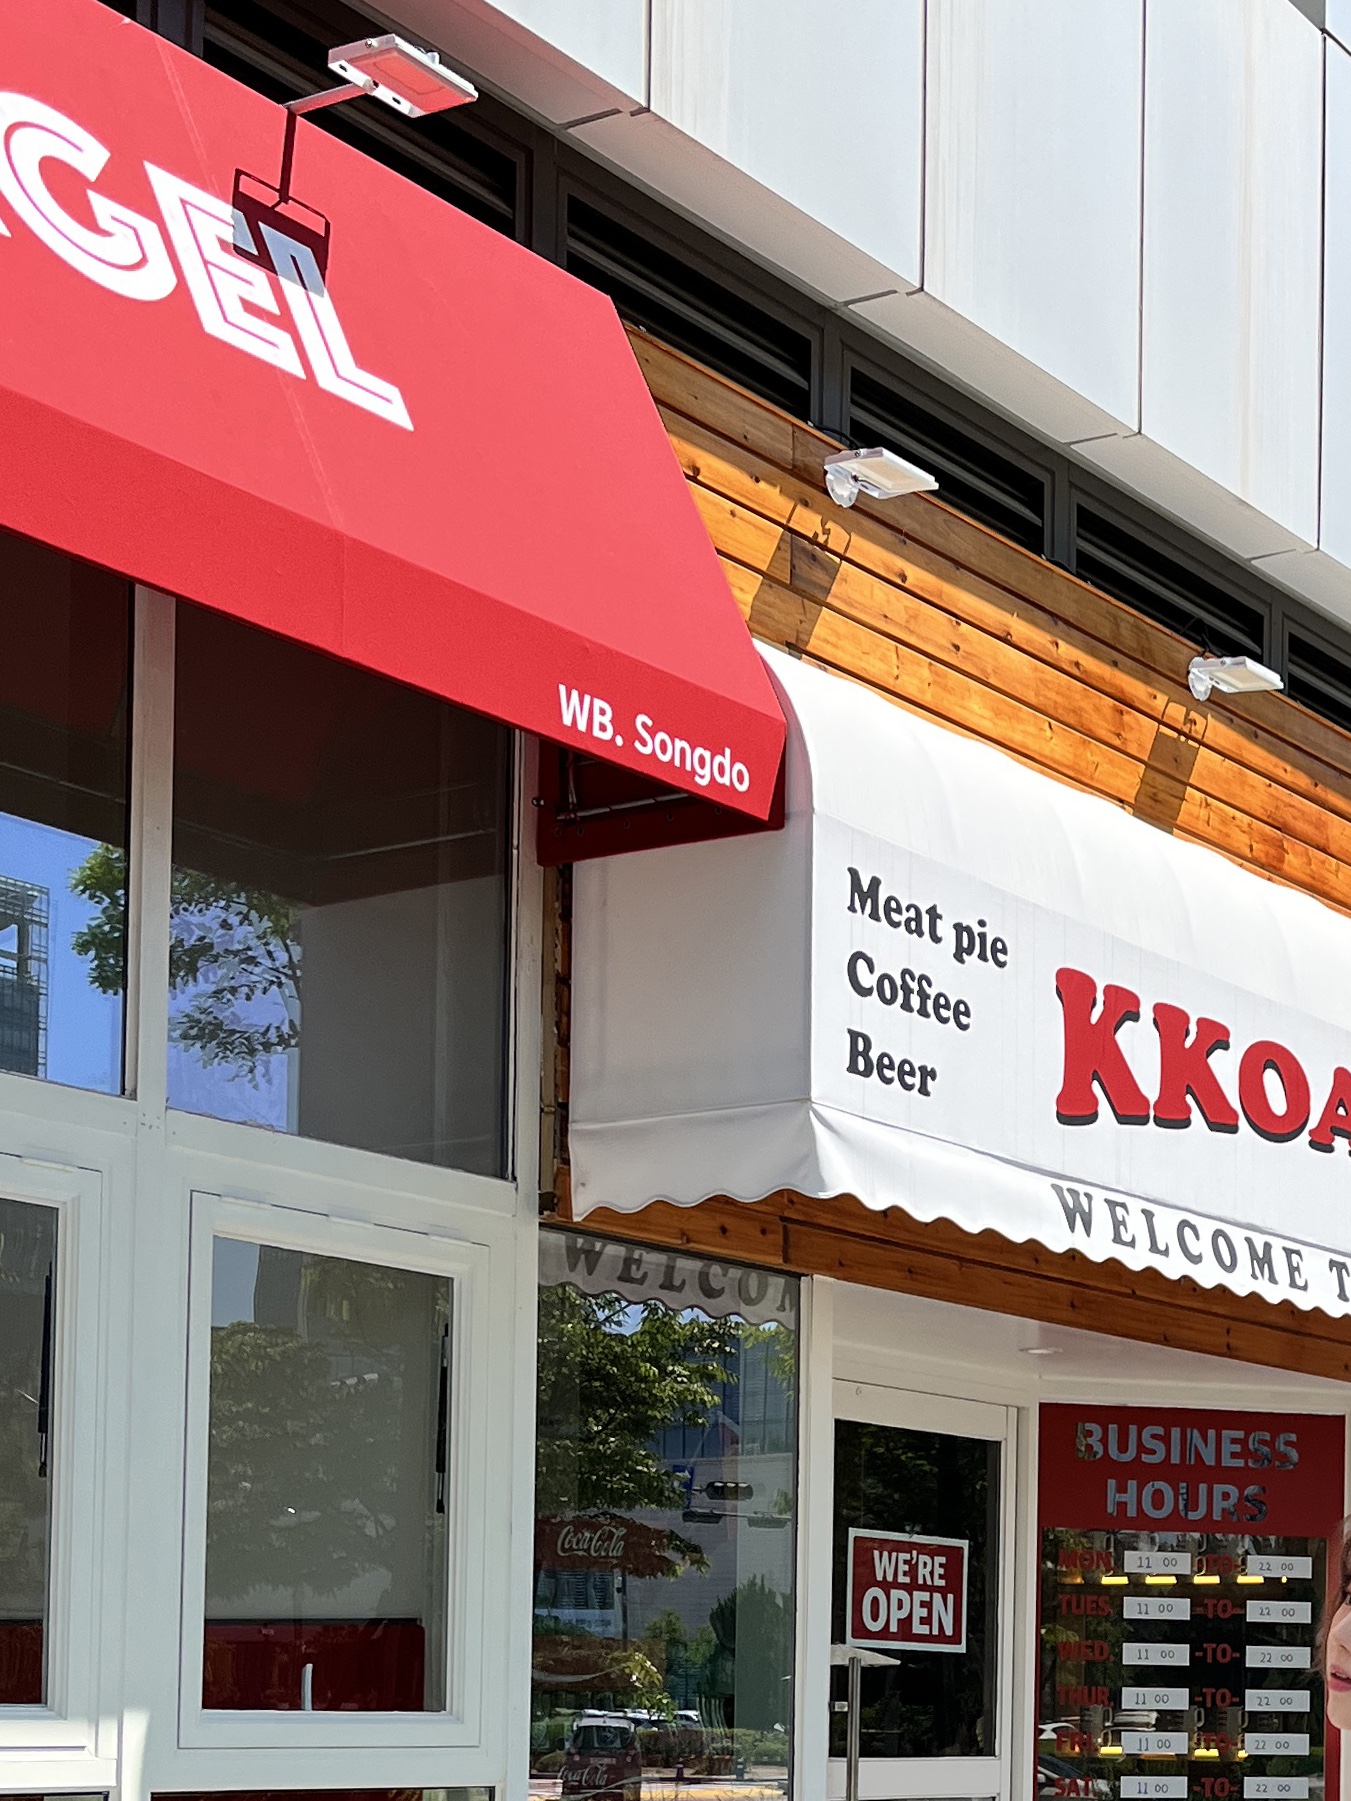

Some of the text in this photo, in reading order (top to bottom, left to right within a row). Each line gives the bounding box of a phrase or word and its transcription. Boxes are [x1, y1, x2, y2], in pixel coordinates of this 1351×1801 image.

[0, 91, 414, 432] GEL
[558, 683, 750, 793] WB. Songdo
[846, 866, 1009, 969] Meat pie
[846, 950, 972, 1032] Coffee
[846, 1027, 938, 1097] Beer
[1050, 1182, 1308, 1293] WELCOME
[1075, 1422, 1300, 1470] BUSINESS
[1106, 1478, 1269, 1522] HOURS
[873, 1549, 947, 1587] WE'RE
[861, 1587, 955, 1637] OPEN
[1194, 1643, 1240, 1664] -TO-
[1194, 1687, 1240, 1708] -TO-
